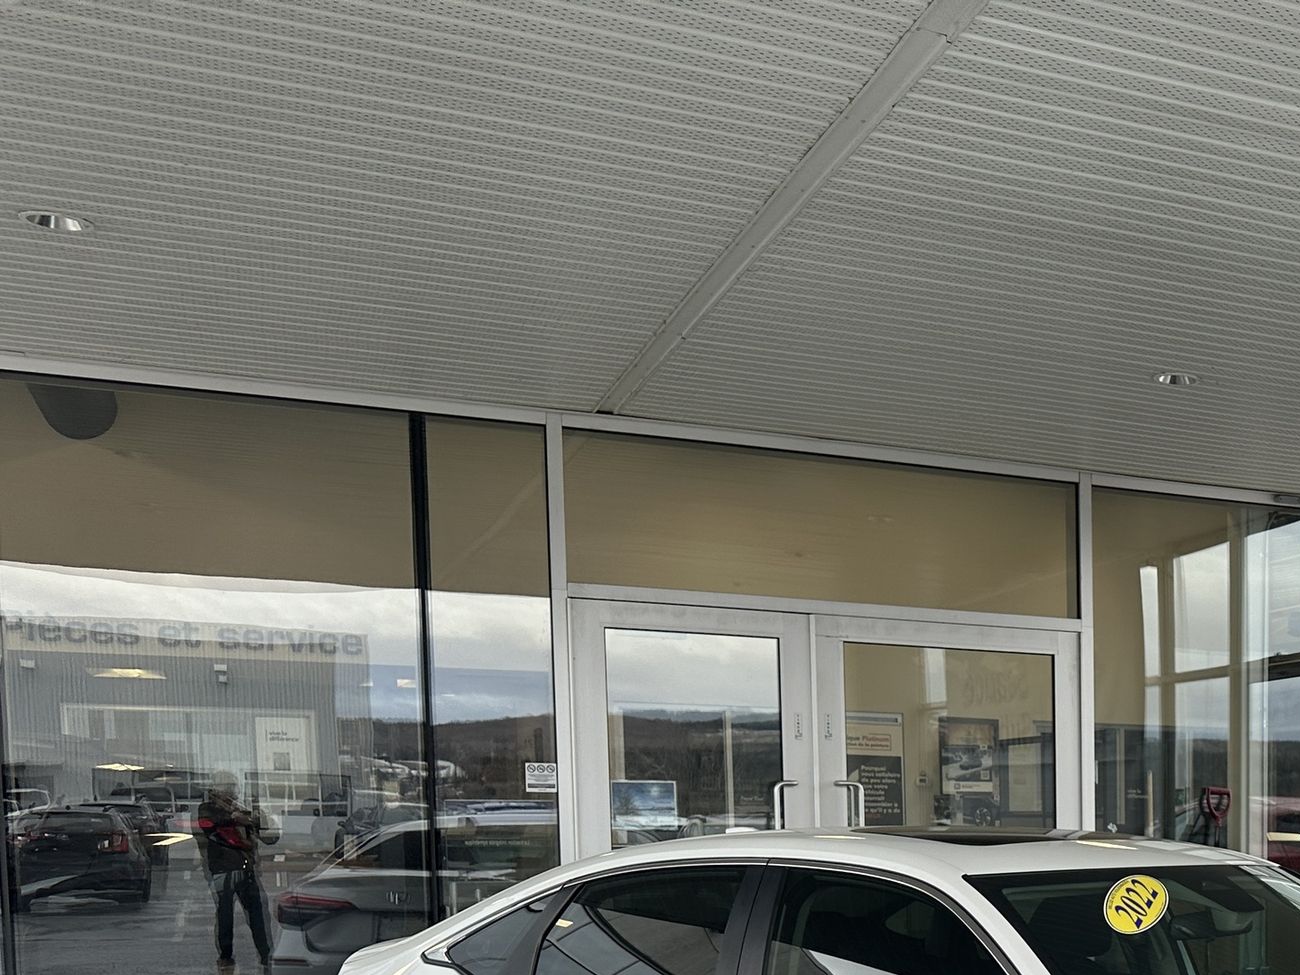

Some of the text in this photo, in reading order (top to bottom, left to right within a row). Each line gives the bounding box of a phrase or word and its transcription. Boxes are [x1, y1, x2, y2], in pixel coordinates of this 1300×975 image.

[158, 621, 201, 648] et
[217, 625, 364, 656] service
[1115, 879, 1159, 929] 2022
